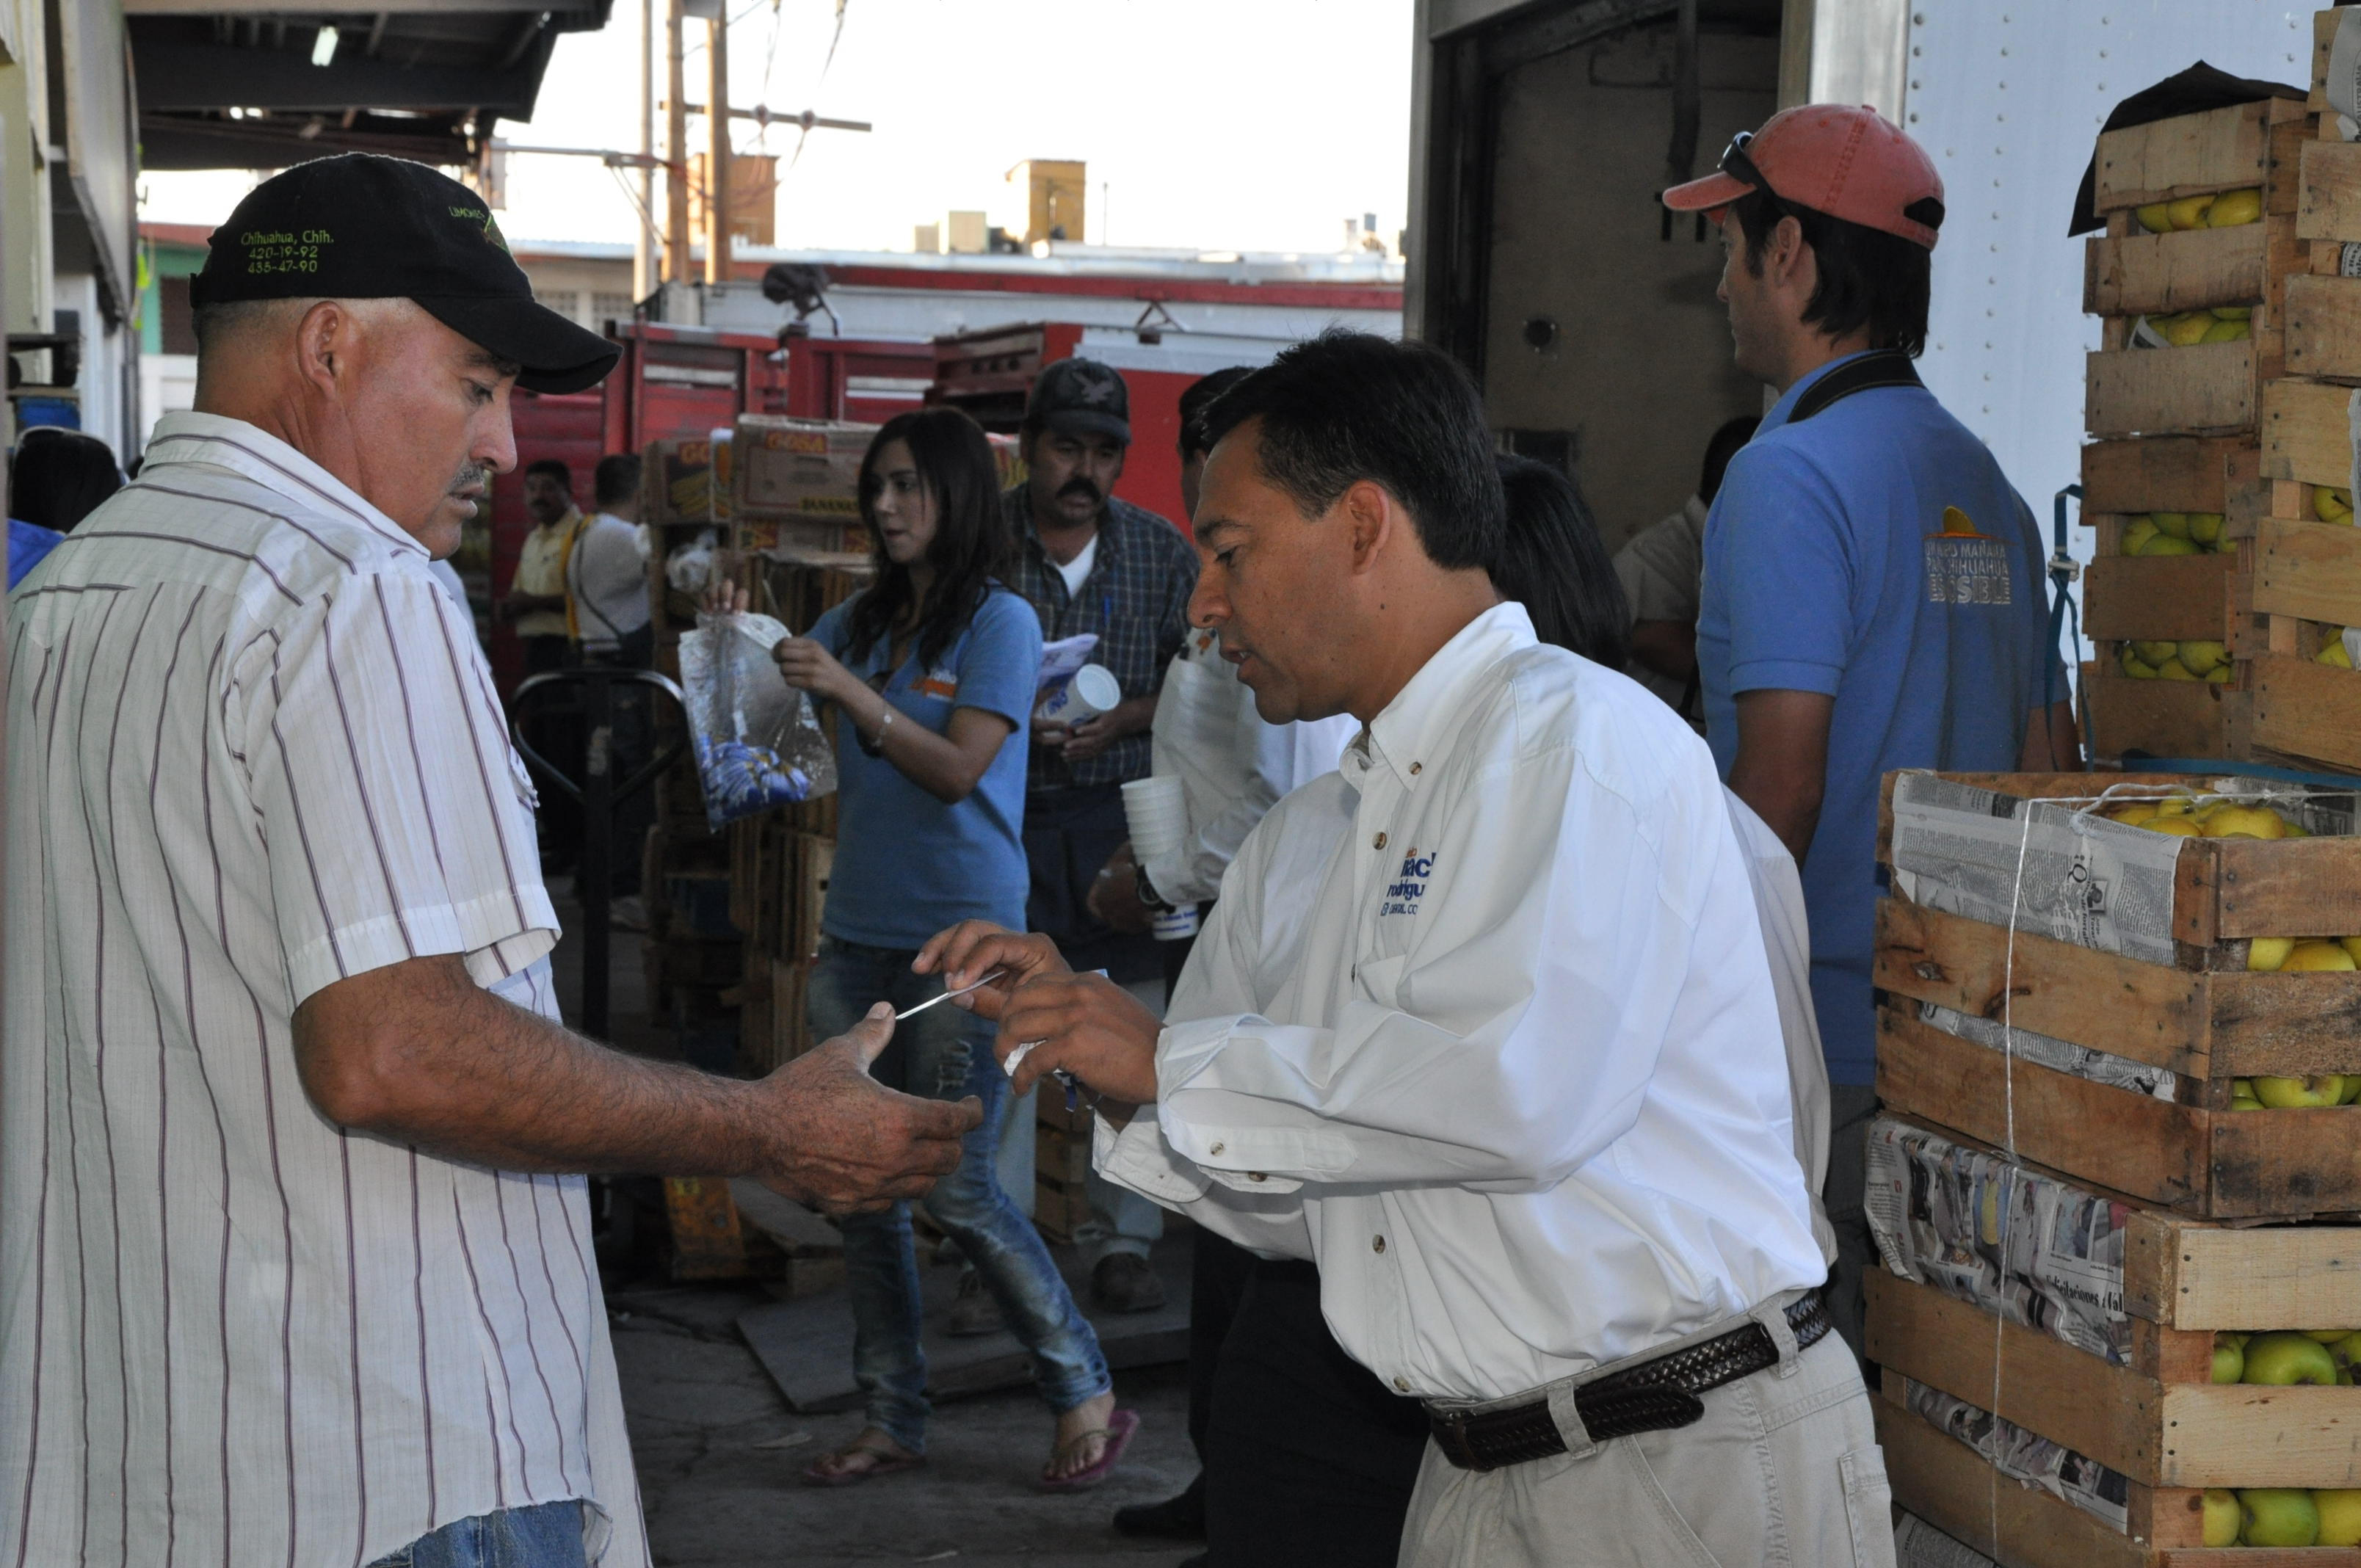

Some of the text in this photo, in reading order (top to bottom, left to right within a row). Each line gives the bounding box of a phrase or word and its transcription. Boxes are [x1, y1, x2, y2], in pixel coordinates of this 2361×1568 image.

[241, 229, 334, 245] Chihuahua, Chih.
[249, 245, 318, 259] 420-19-92
[247, 260, 317, 274] 435-47-90
[767, 431, 824, 452] GOSA
[1961, 540, 2006, 559] MAÑANA
